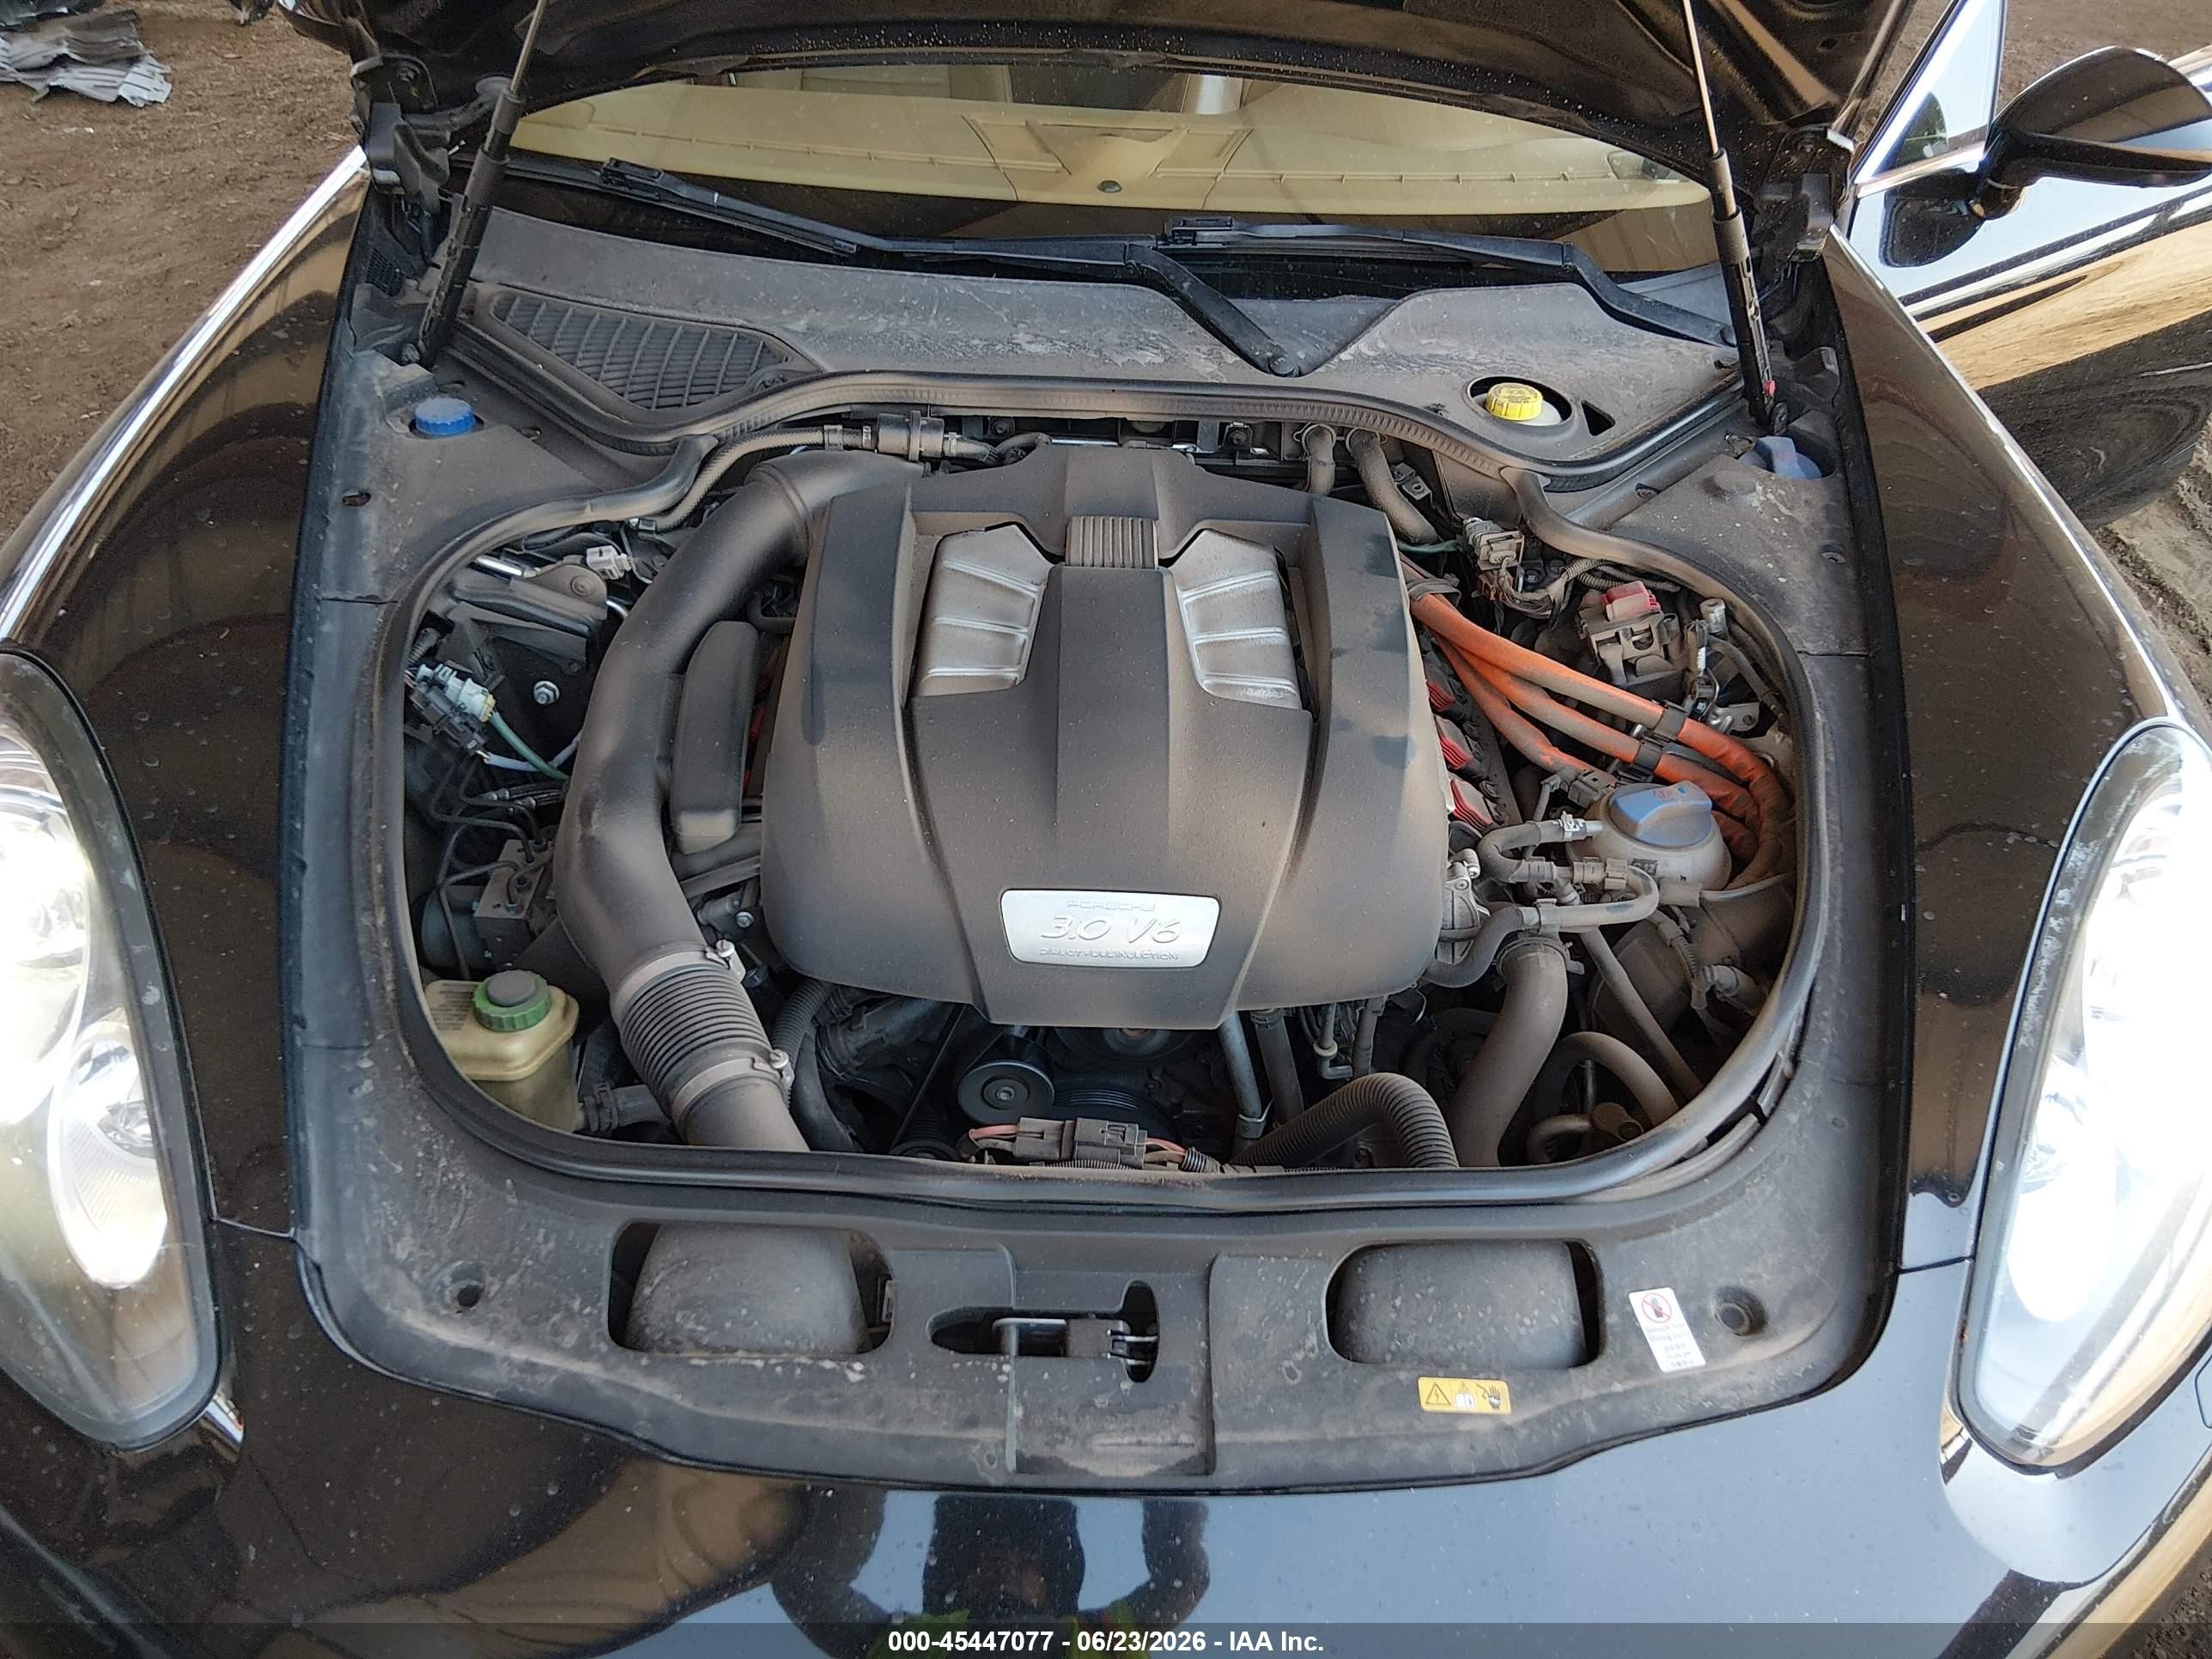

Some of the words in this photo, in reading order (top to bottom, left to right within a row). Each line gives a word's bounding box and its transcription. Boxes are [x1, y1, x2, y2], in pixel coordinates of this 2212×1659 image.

[1066, 899, 1156, 912] PORSCHE
[1040, 914, 1112, 941] 3.0
[1127, 916, 1182, 944] V6
[1039, 947, 1082, 957] DIRECT
[1115, 949, 1179, 961] INJECTION
